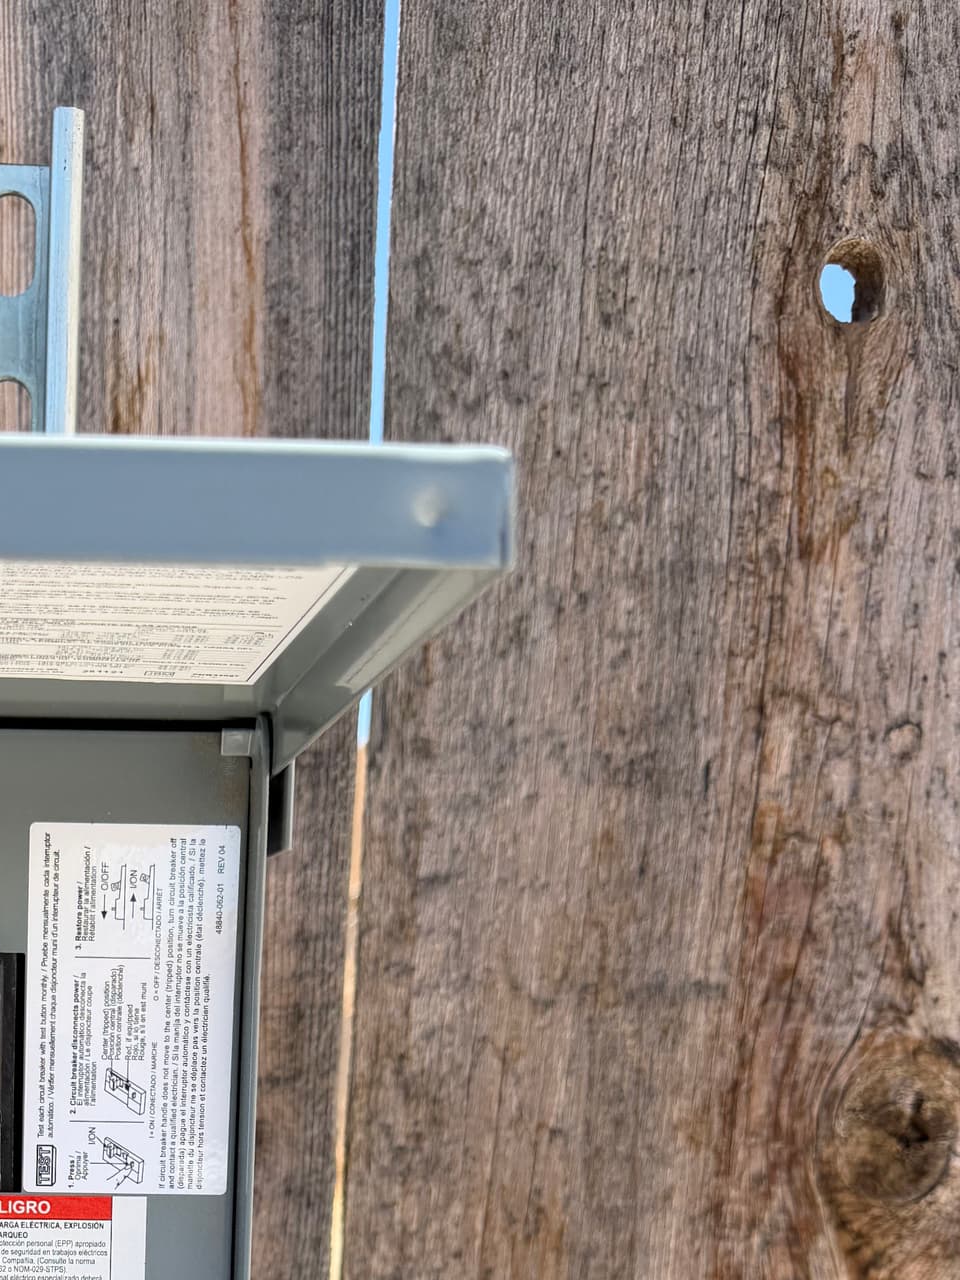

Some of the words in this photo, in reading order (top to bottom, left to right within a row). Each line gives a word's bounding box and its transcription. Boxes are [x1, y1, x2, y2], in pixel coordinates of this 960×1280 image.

[166, 960, 174, 992] (tripped)
[39, 1147, 50, 1184] TEST
[64, 1221, 104, 1229] EXPLOSIÓN
